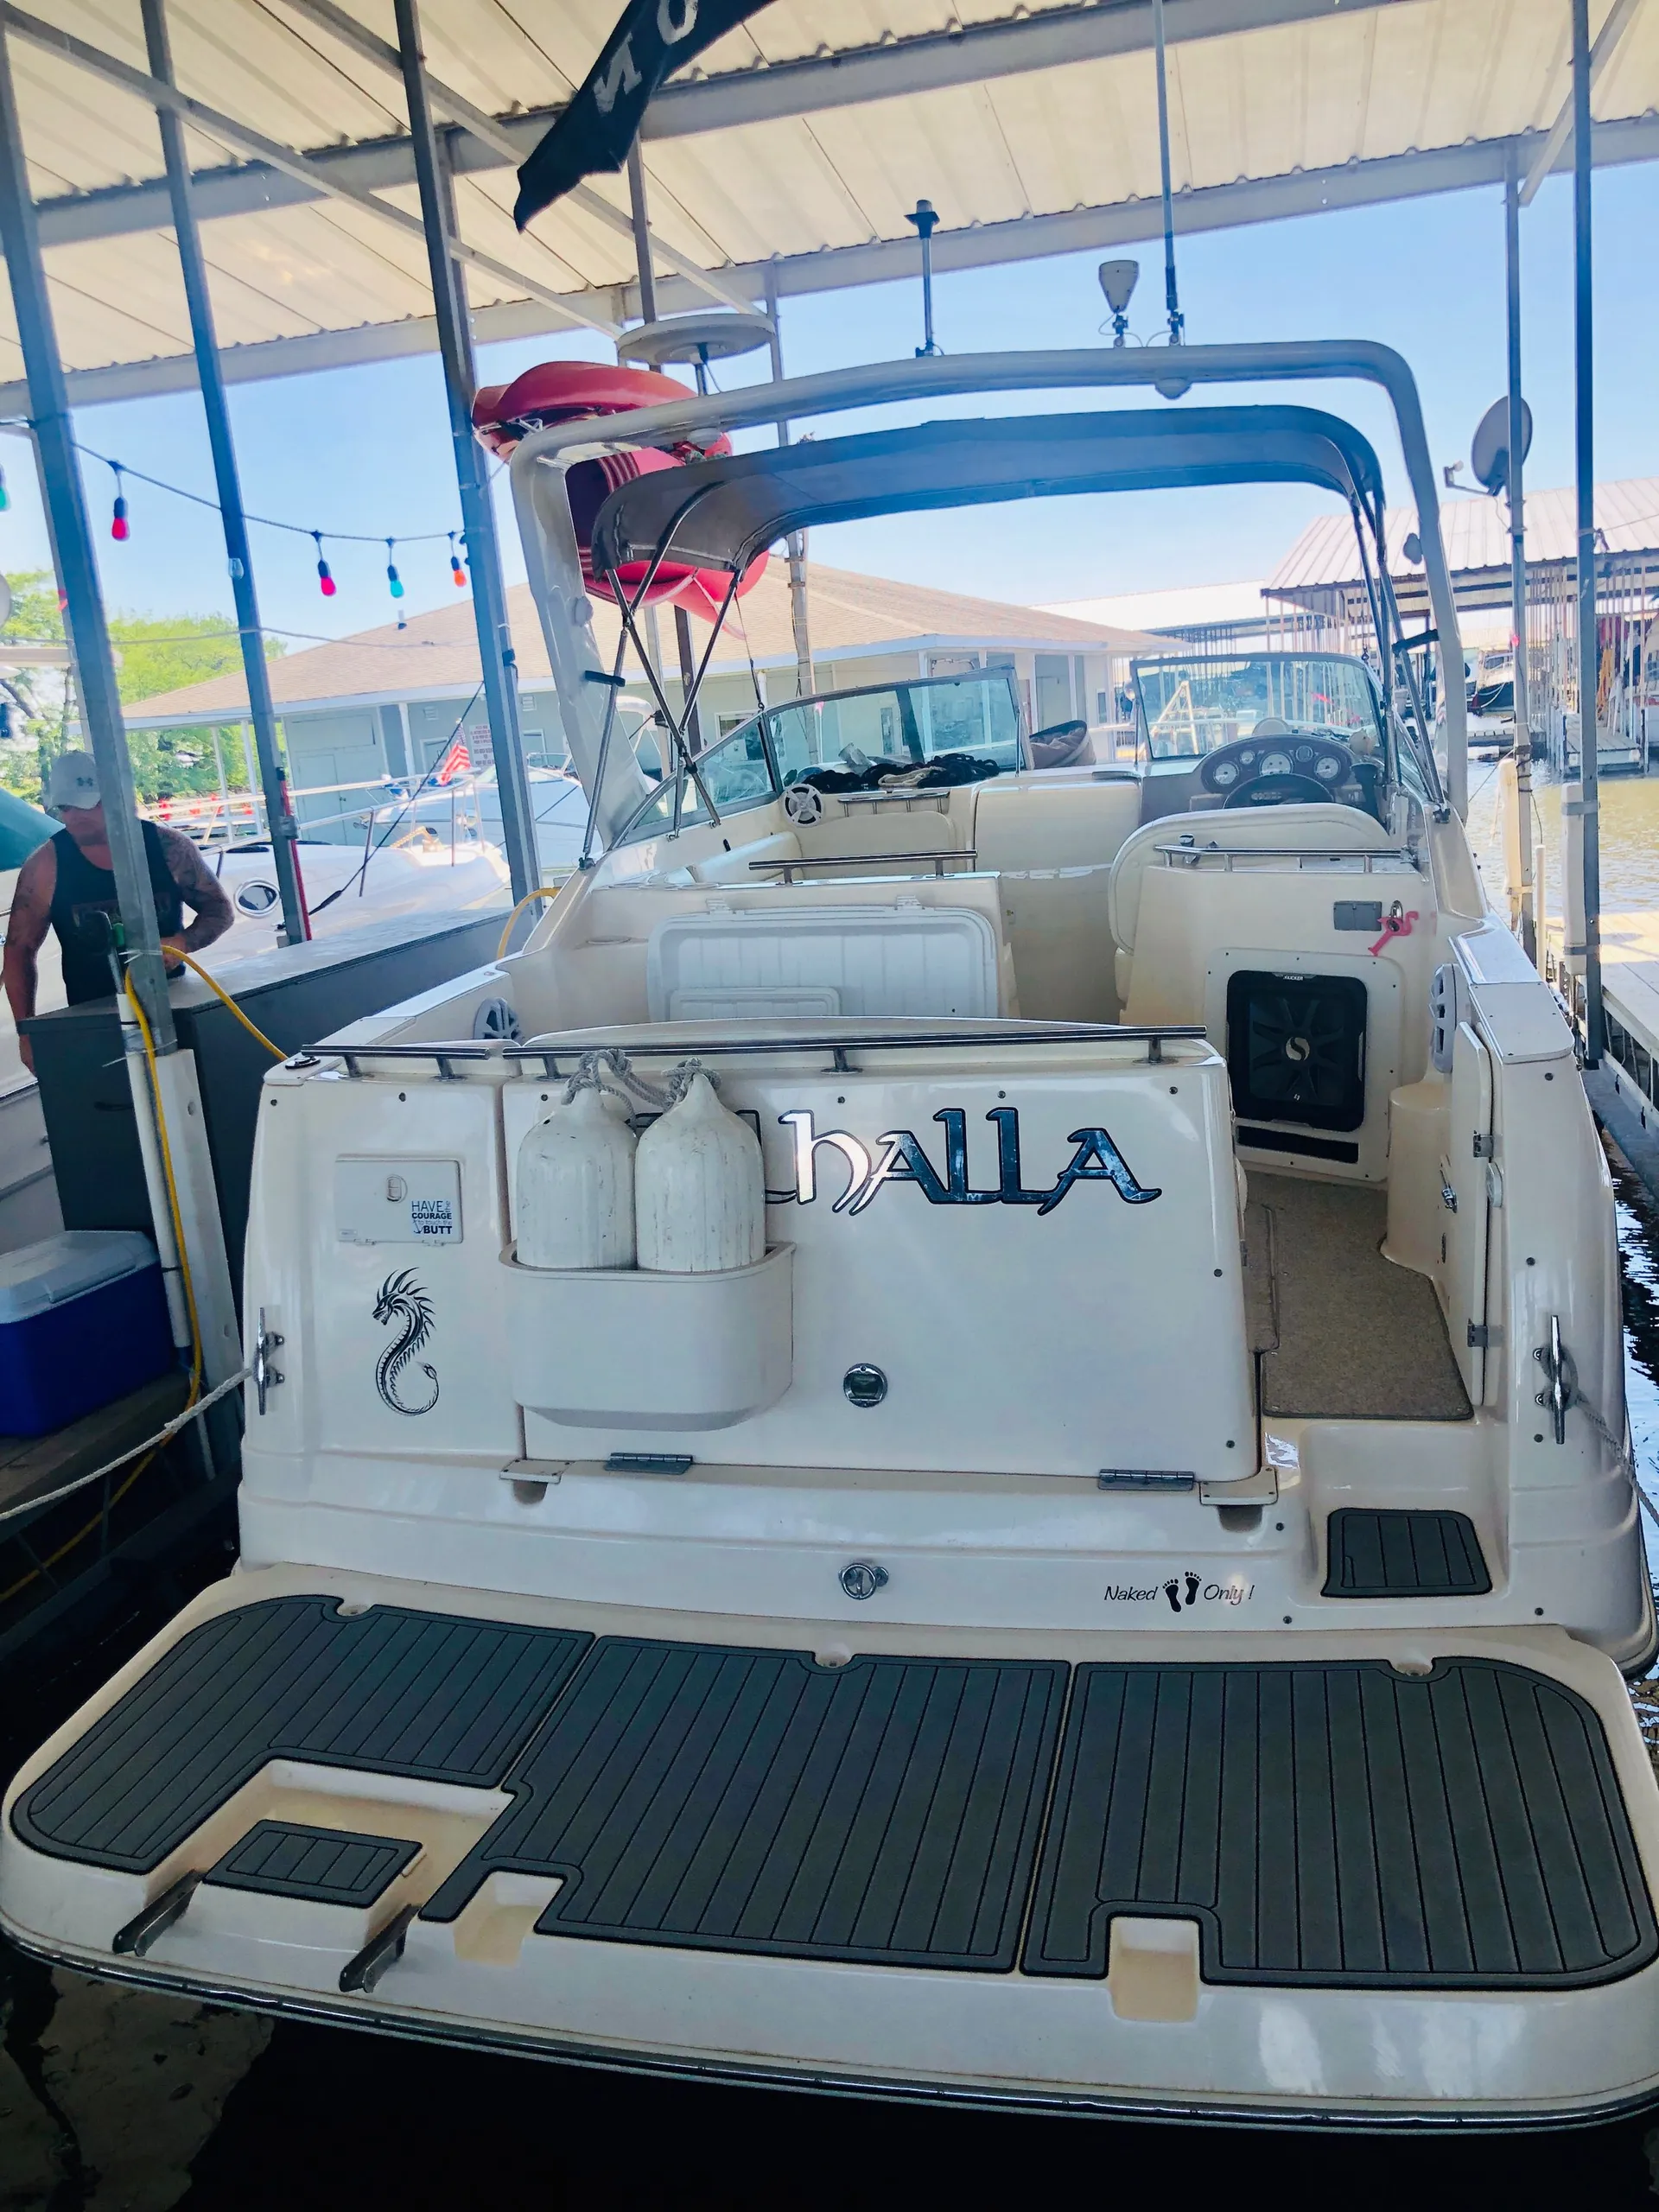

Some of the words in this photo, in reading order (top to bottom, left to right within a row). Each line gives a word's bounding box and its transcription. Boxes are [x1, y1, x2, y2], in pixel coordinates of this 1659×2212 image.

[411, 1200, 444, 1212] HAVE
[423, 1225, 452, 1234] BUTT
[1103, 1585, 1159, 1601] Naked
